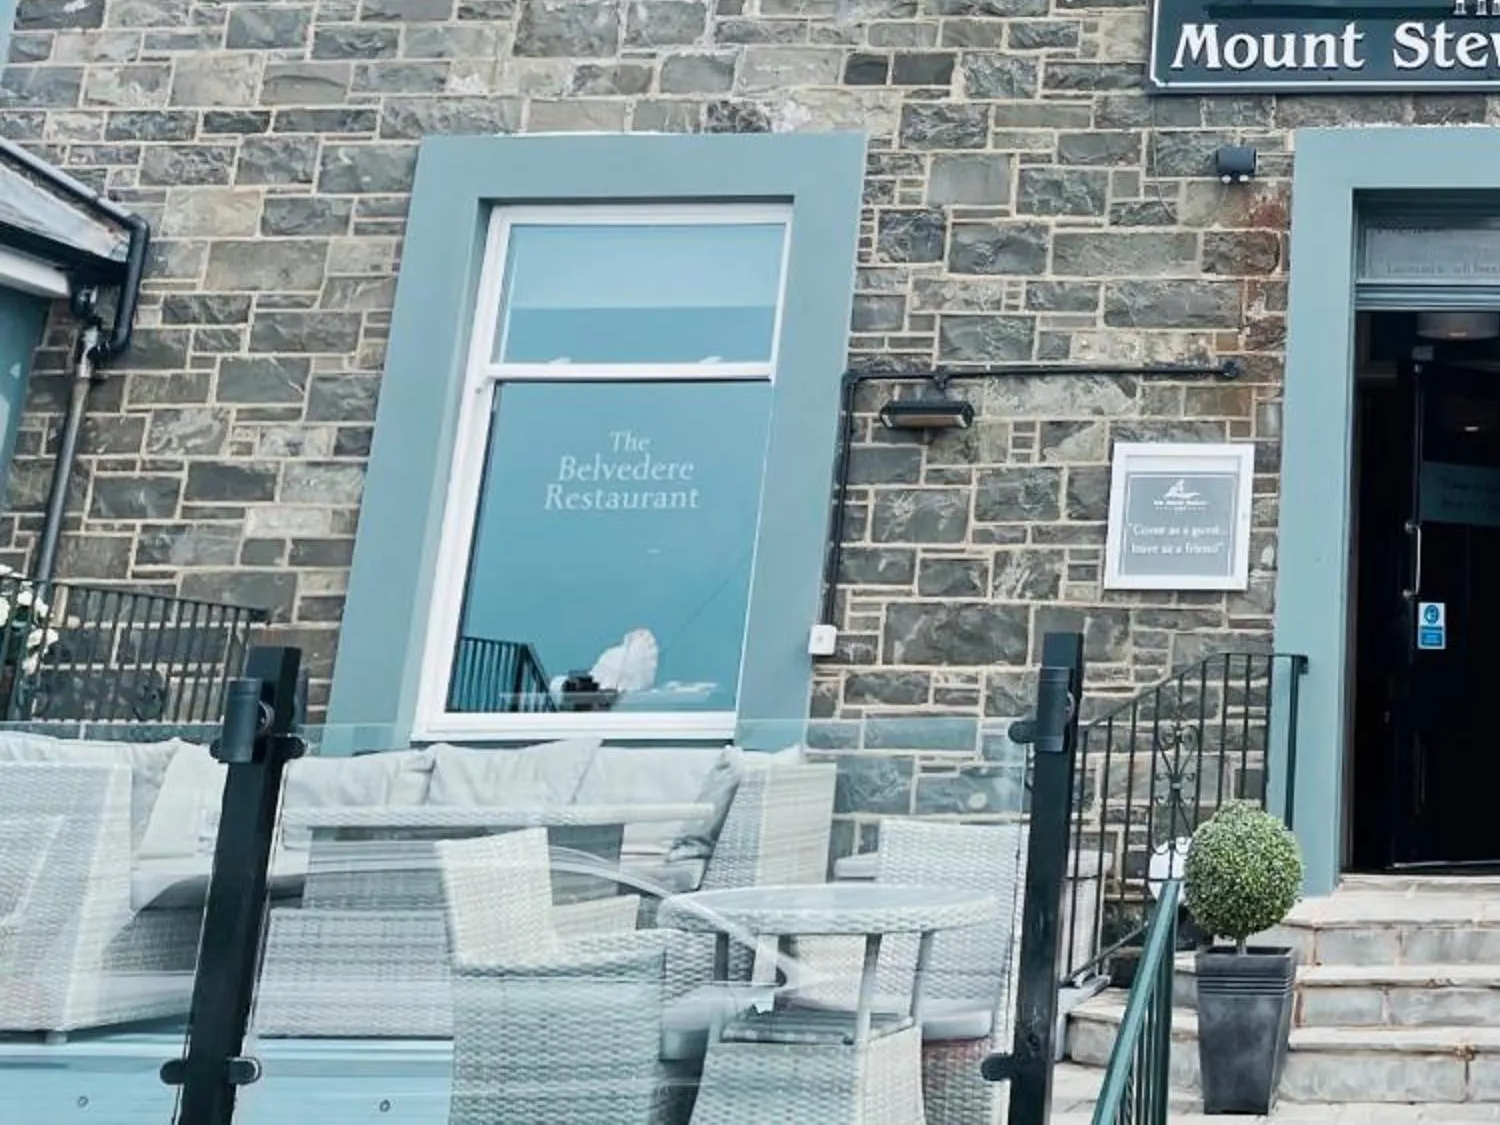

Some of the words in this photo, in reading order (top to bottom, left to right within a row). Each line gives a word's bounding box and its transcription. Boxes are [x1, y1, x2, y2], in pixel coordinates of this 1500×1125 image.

[1170, 22, 1365, 71] Mount
[609, 429, 650, 453] The
[557, 453, 695, 482] Belvedere
[543, 483, 701, 511] Restaurant
